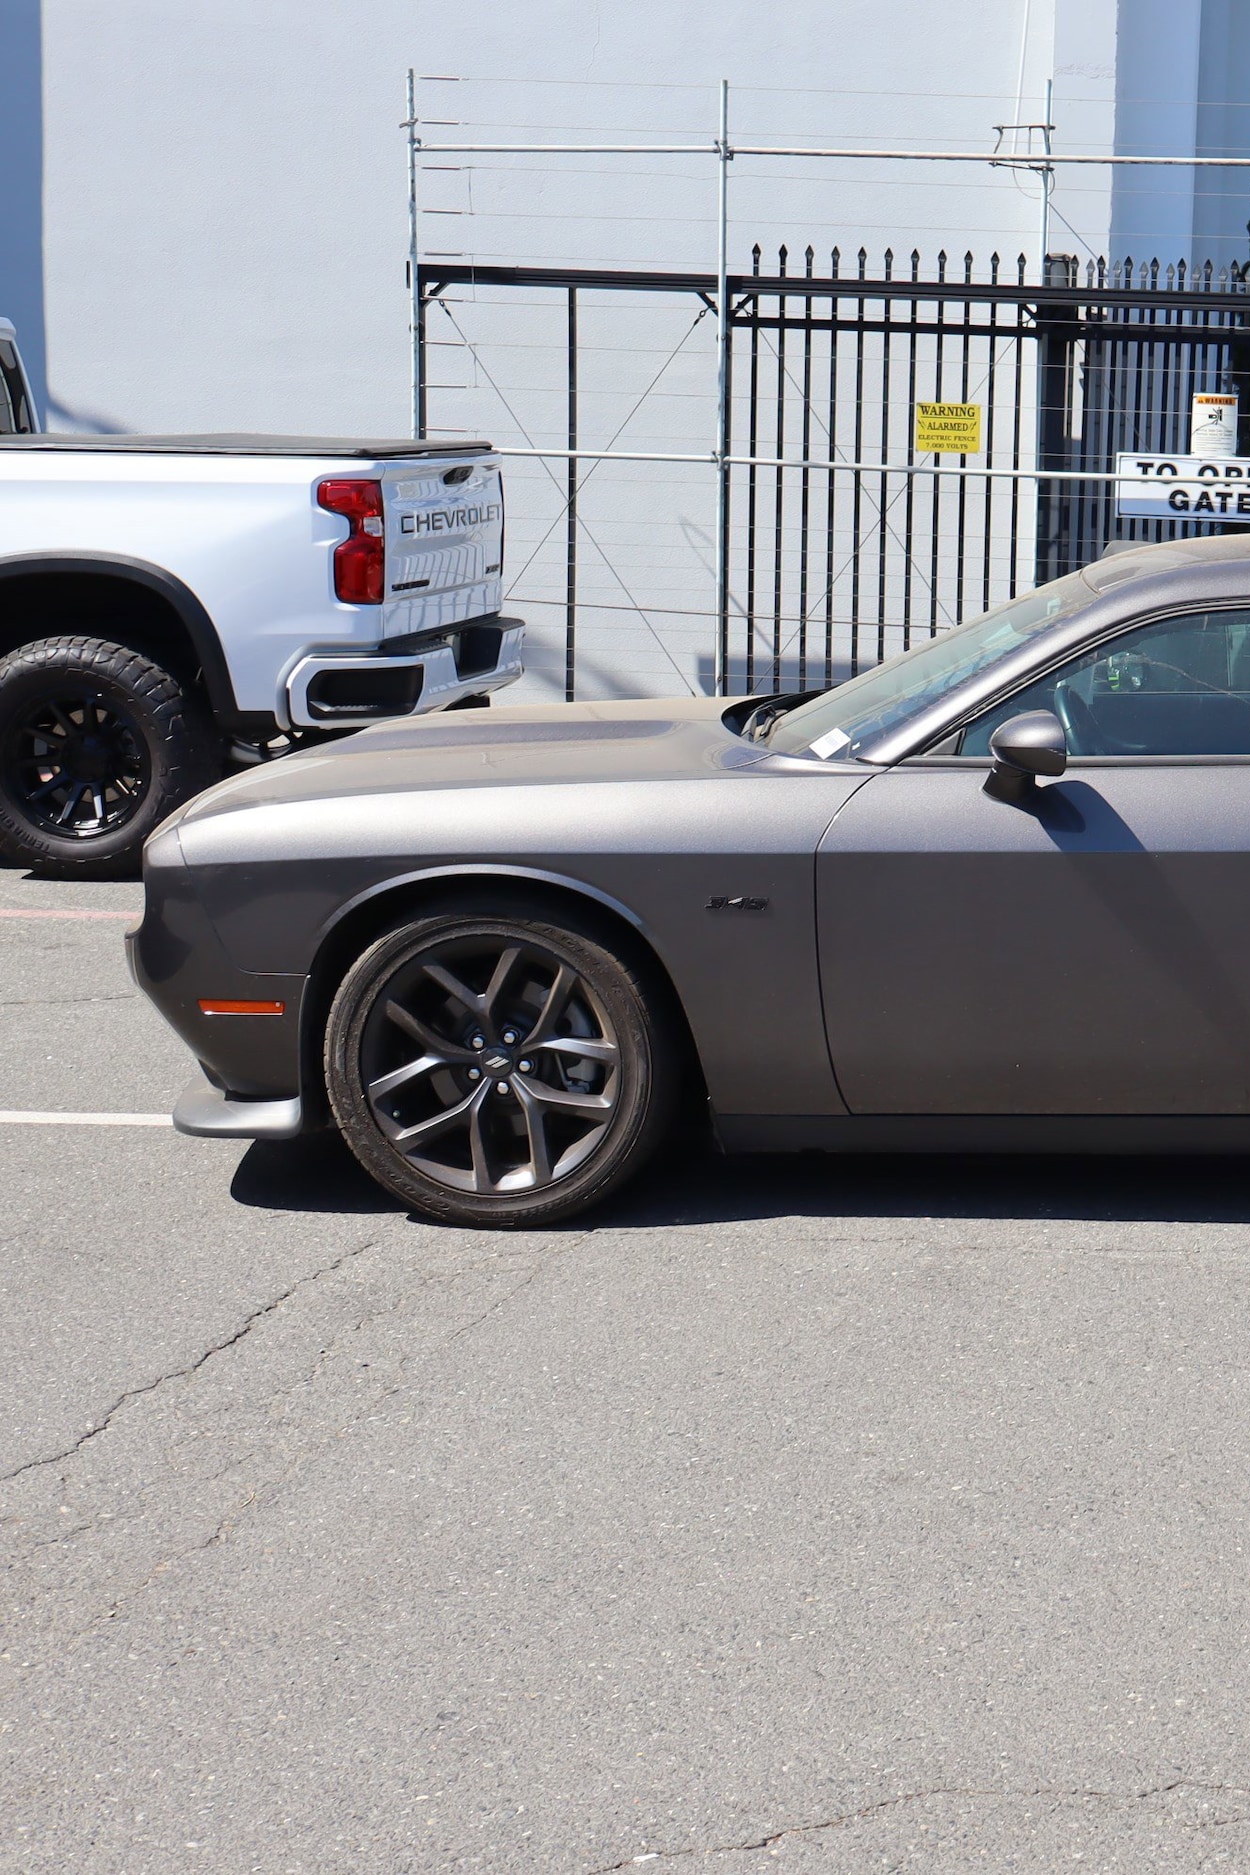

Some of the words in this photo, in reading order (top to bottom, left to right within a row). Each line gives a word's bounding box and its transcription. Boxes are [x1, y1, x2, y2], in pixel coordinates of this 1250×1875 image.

[920, 405, 976, 418] WARNING
[927, 422, 969, 432] ALARMED
[1136, 462, 1179, 484] TO
[401, 504, 501, 534] CHEVROLET
